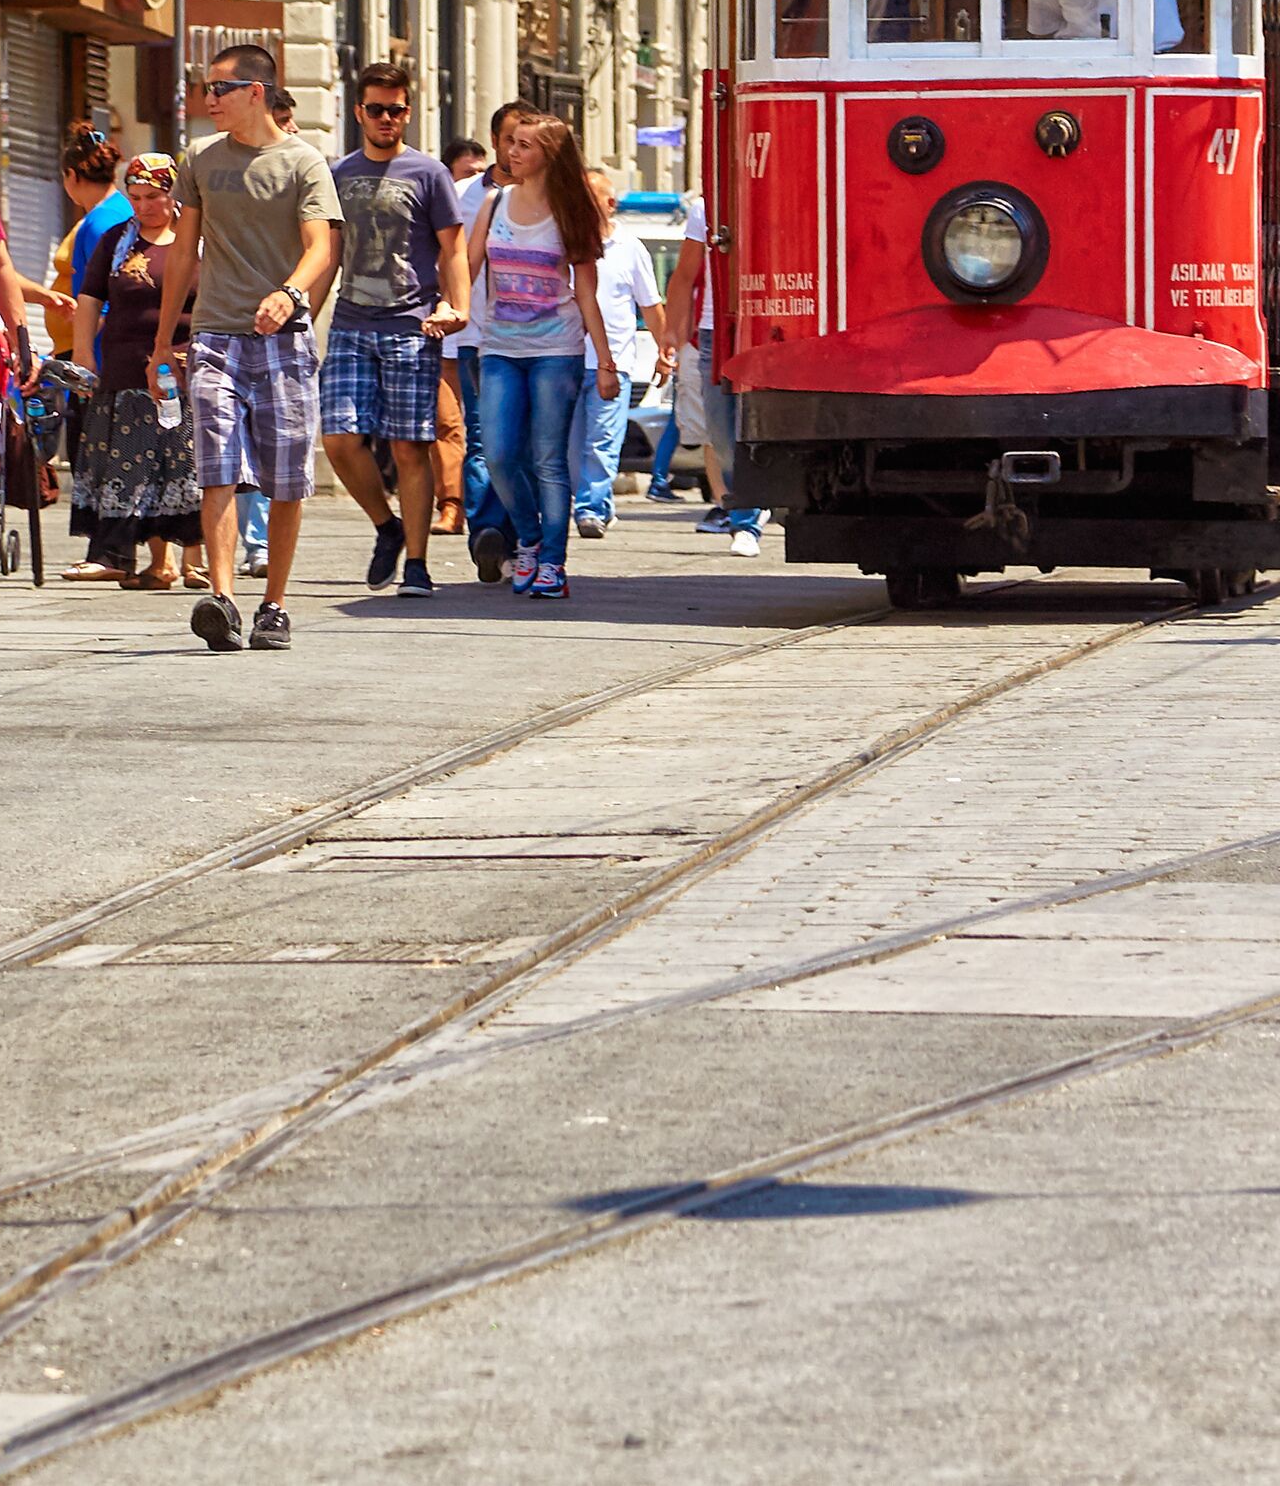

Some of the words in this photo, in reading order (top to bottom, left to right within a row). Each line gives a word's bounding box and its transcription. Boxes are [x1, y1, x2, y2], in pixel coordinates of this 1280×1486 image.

[744, 131, 772, 179] 47
[1206, 128, 1240, 175] 47
[773, 273, 814, 290] YASAK
[1170, 263, 1226, 281] ASILMAK
[1170, 288, 1189, 307] VE
